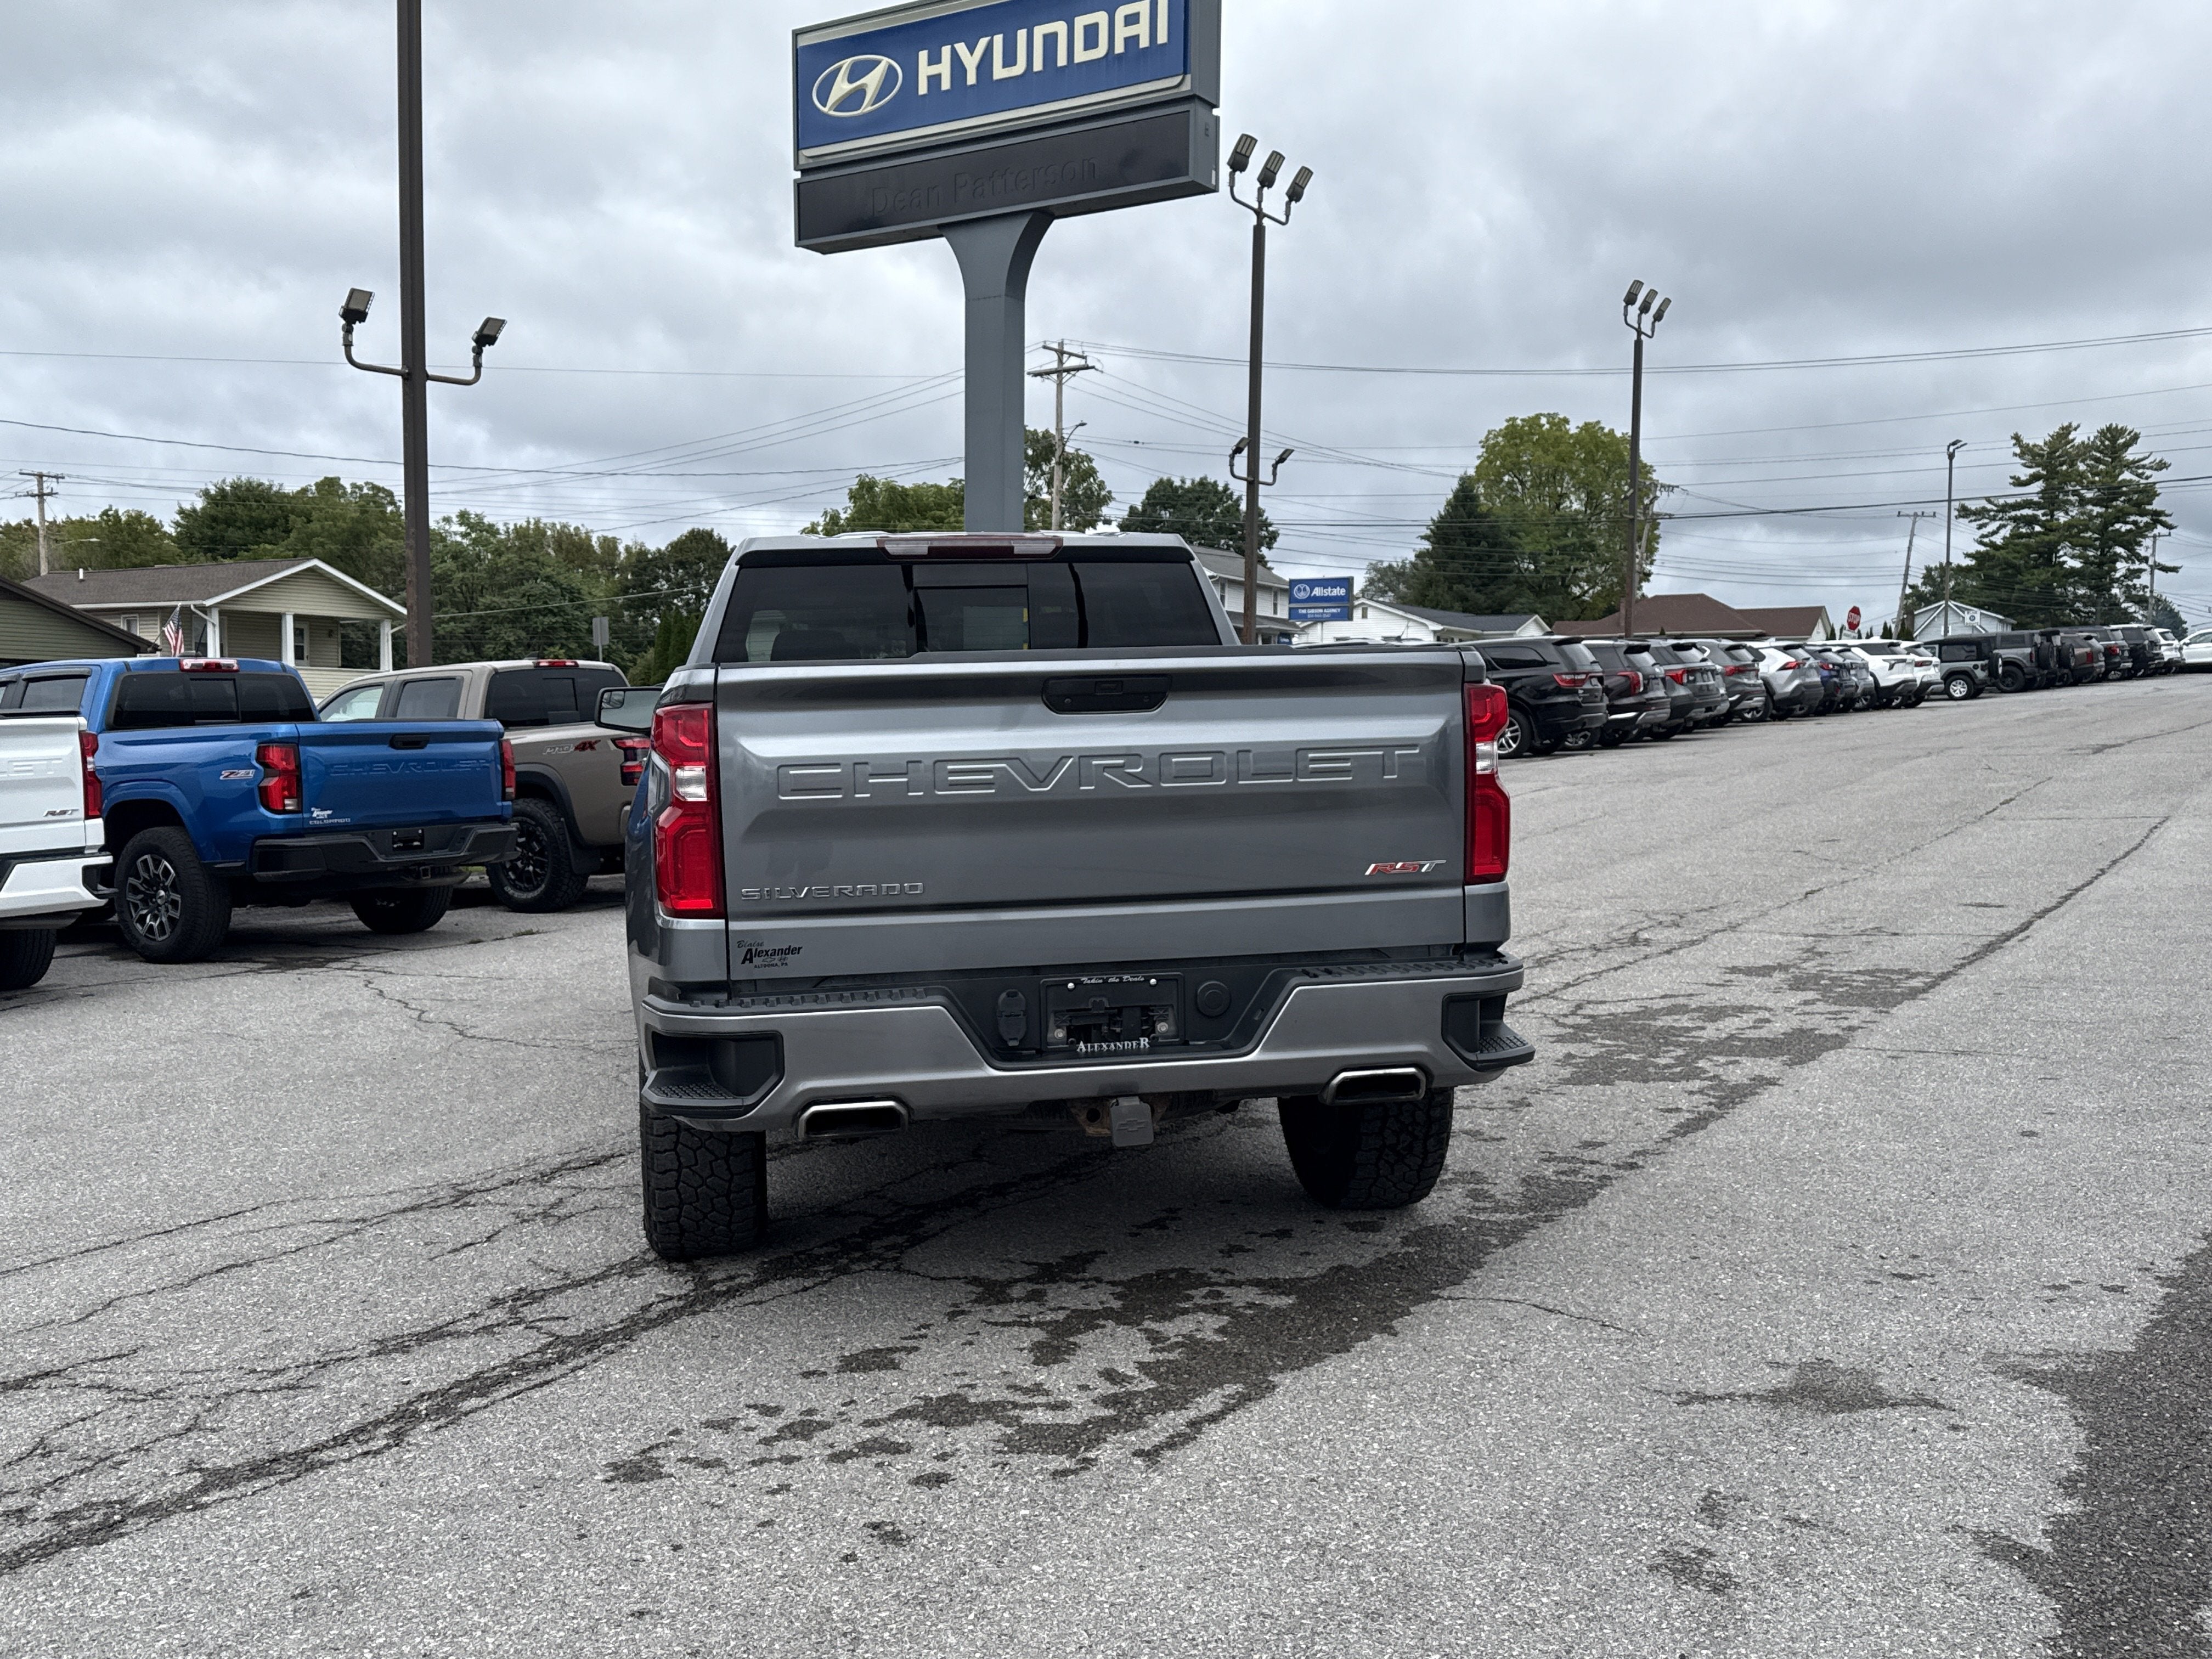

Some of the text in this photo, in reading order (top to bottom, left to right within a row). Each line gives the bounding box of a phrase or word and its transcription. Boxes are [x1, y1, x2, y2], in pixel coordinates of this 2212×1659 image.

[918, 0, 1168, 95] HYUNDAI
[872, 156, 1097, 218] Dean Patterson
[1311, 586, 1346, 597] Allstate
[1848, 612, 1860, 624] STOP
[219, 769, 256, 780] Z71
[330, 759, 490, 776] CHEVROLET
[777, 744, 1420, 800] CHEVROLET
[43, 808, 80, 817] RST
[1364, 860, 1447, 876] RST
[741, 882, 924, 900] SILVERADO
[741, 945, 803, 964] Alexander
[1076, 1037, 1150, 1053] ALEXANDER
